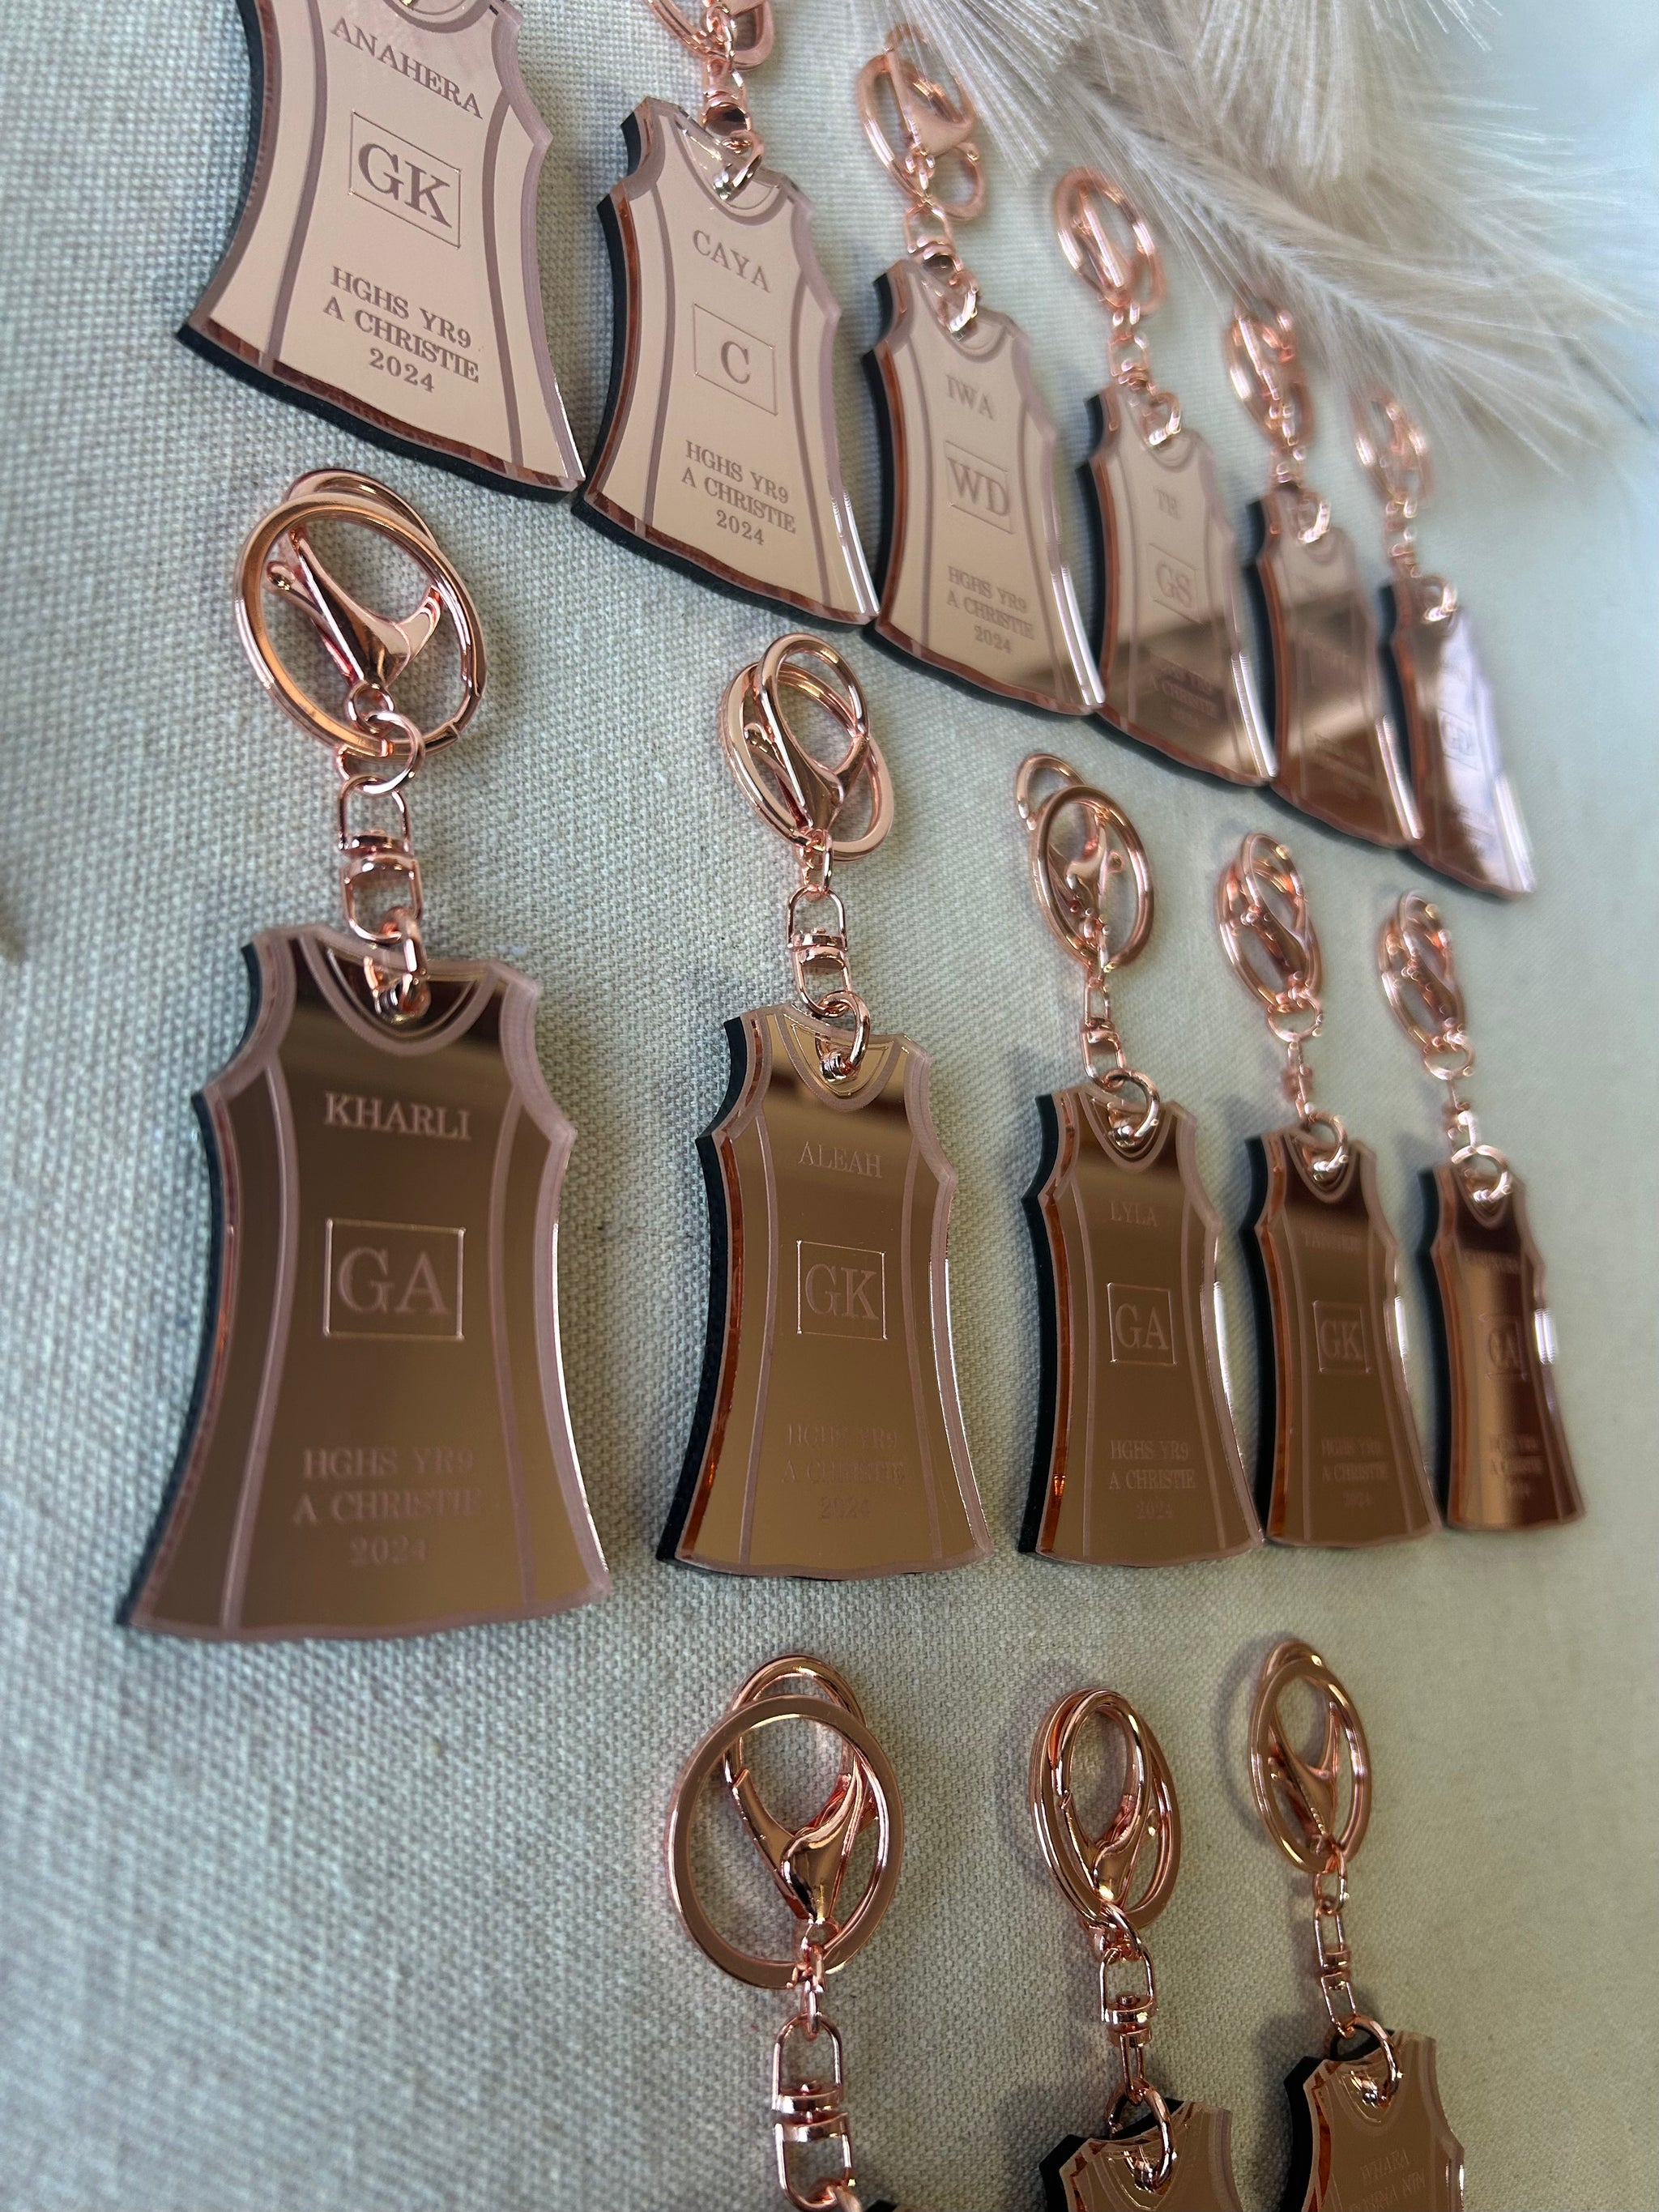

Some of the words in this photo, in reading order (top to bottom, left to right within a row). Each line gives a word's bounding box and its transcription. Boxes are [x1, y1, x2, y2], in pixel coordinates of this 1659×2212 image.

[330, 16, 484, 120] ANAHERA
[358, 143, 452, 228] GK
[693, 229, 770, 293] CAYA
[331, 266, 410, 320] HGHS
[419, 305, 471, 349] YR9
[323, 296, 345, 322] A
[355, 309, 479, 383] CHRISTIE
[720, 340, 751, 385] C
[369, 348, 435, 394] 2024
[685, 440, 744, 484] HGHS
[749, 471, 789, 505] YR9
[947, 456, 1009, 517] WD
[681, 467, 697, 488] A
[704, 476, 795, 535] CHRISTIE
[715, 509, 766, 546] 2024
[948, 565, 992, 601] HGHS
[997, 586, 1027, 613] YR9
[946, 590, 961, 609] A
[963, 596, 1035, 641] CHRISTIE
[975, 624, 1013, 654] 2024
[324, 1090, 472, 1141] KHARLI
[798, 1140, 883, 1178] ALEAH
[1109, 1200, 1159, 1228] LYLA
[337, 1247, 450, 1315] GA
[804, 1263, 880, 1320] GK
[1115, 1303, 1169, 1350] GA
[1319, 1319, 1363, 1362] GK
[302, 1446, 399, 1479] HGHS
[292, 1492, 321, 1526] A
